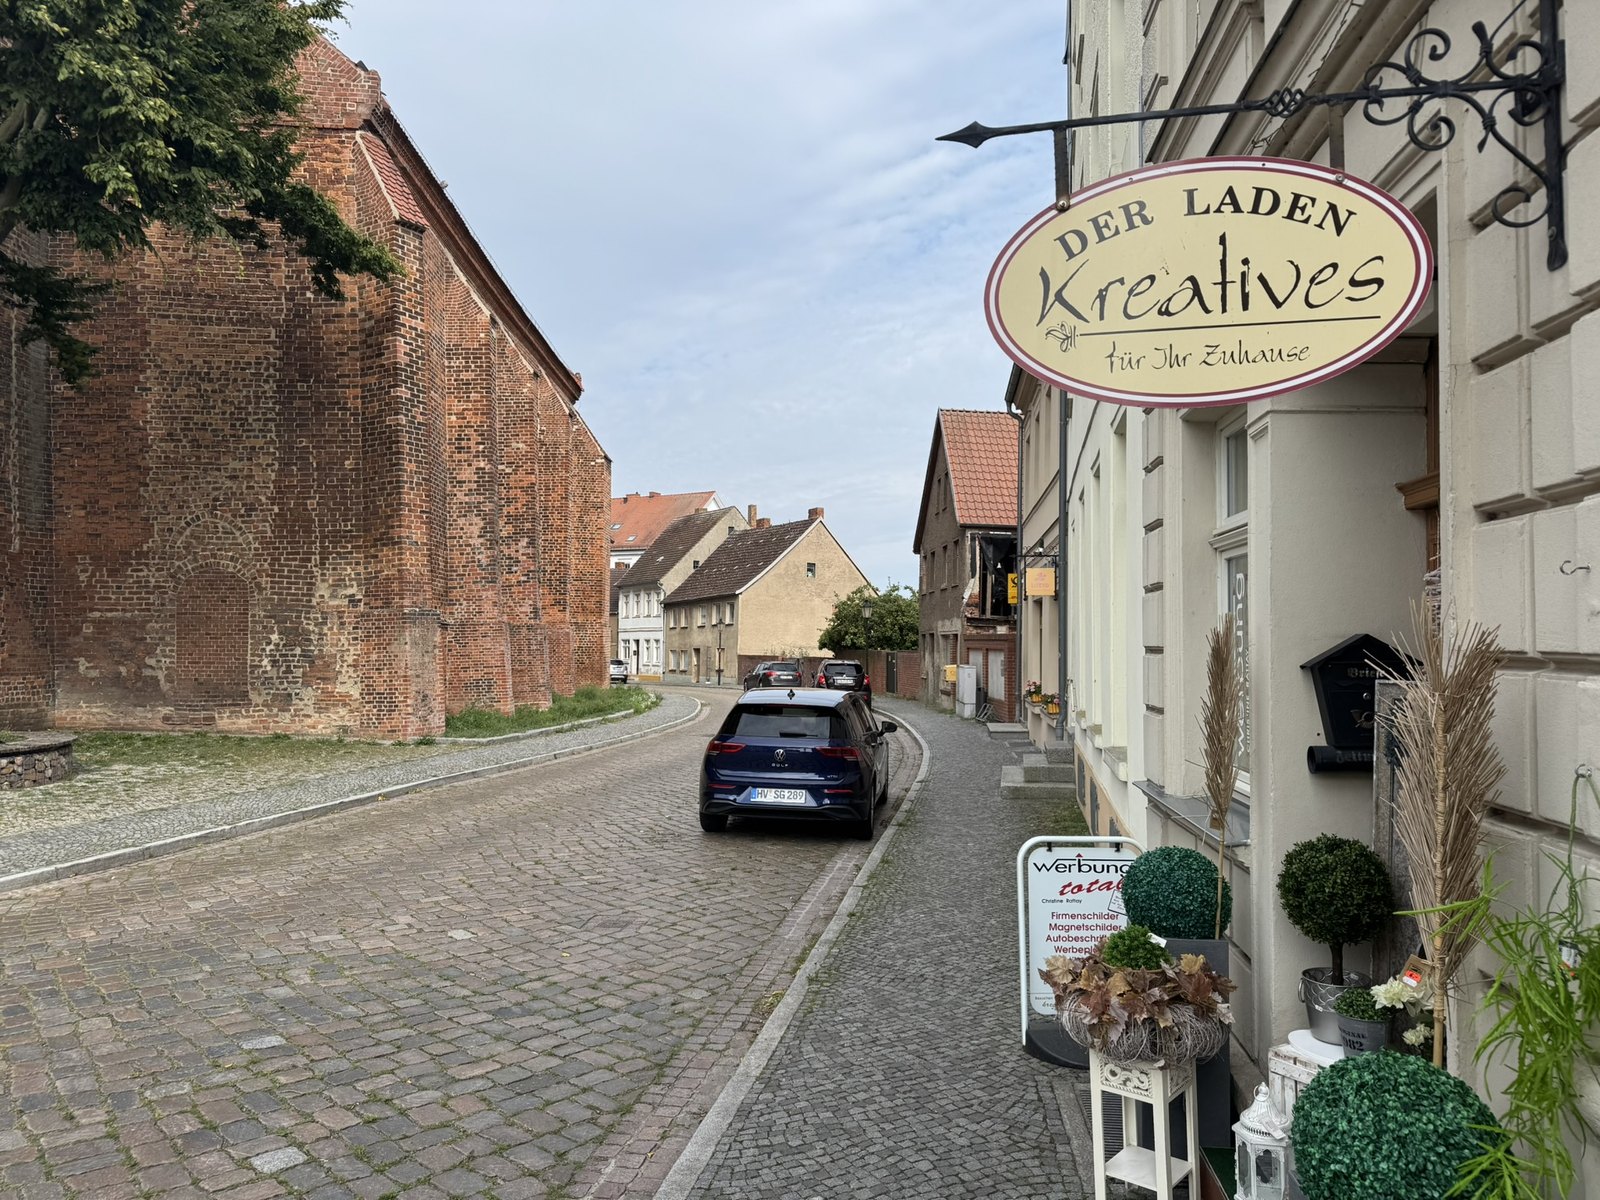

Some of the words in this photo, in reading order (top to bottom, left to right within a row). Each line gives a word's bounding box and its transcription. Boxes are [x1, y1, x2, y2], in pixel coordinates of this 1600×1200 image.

[1053, 200, 1154, 262] DER
[1182, 185, 1357, 237] LADEN
[1036, 231, 1385, 327] Kreatives
[1105, 341, 1146, 374] für
[1199, 339, 1312, 367] Zuhause
[756, 790, 768, 799] HV
[773, 790, 786, 800] SG
[786, 790, 804, 801] 289
[1033, 858, 1129, 879] Werbung
[1051, 912, 1119, 920] Firmenschilder
[1049, 923, 1122, 933] Magnetschilder
